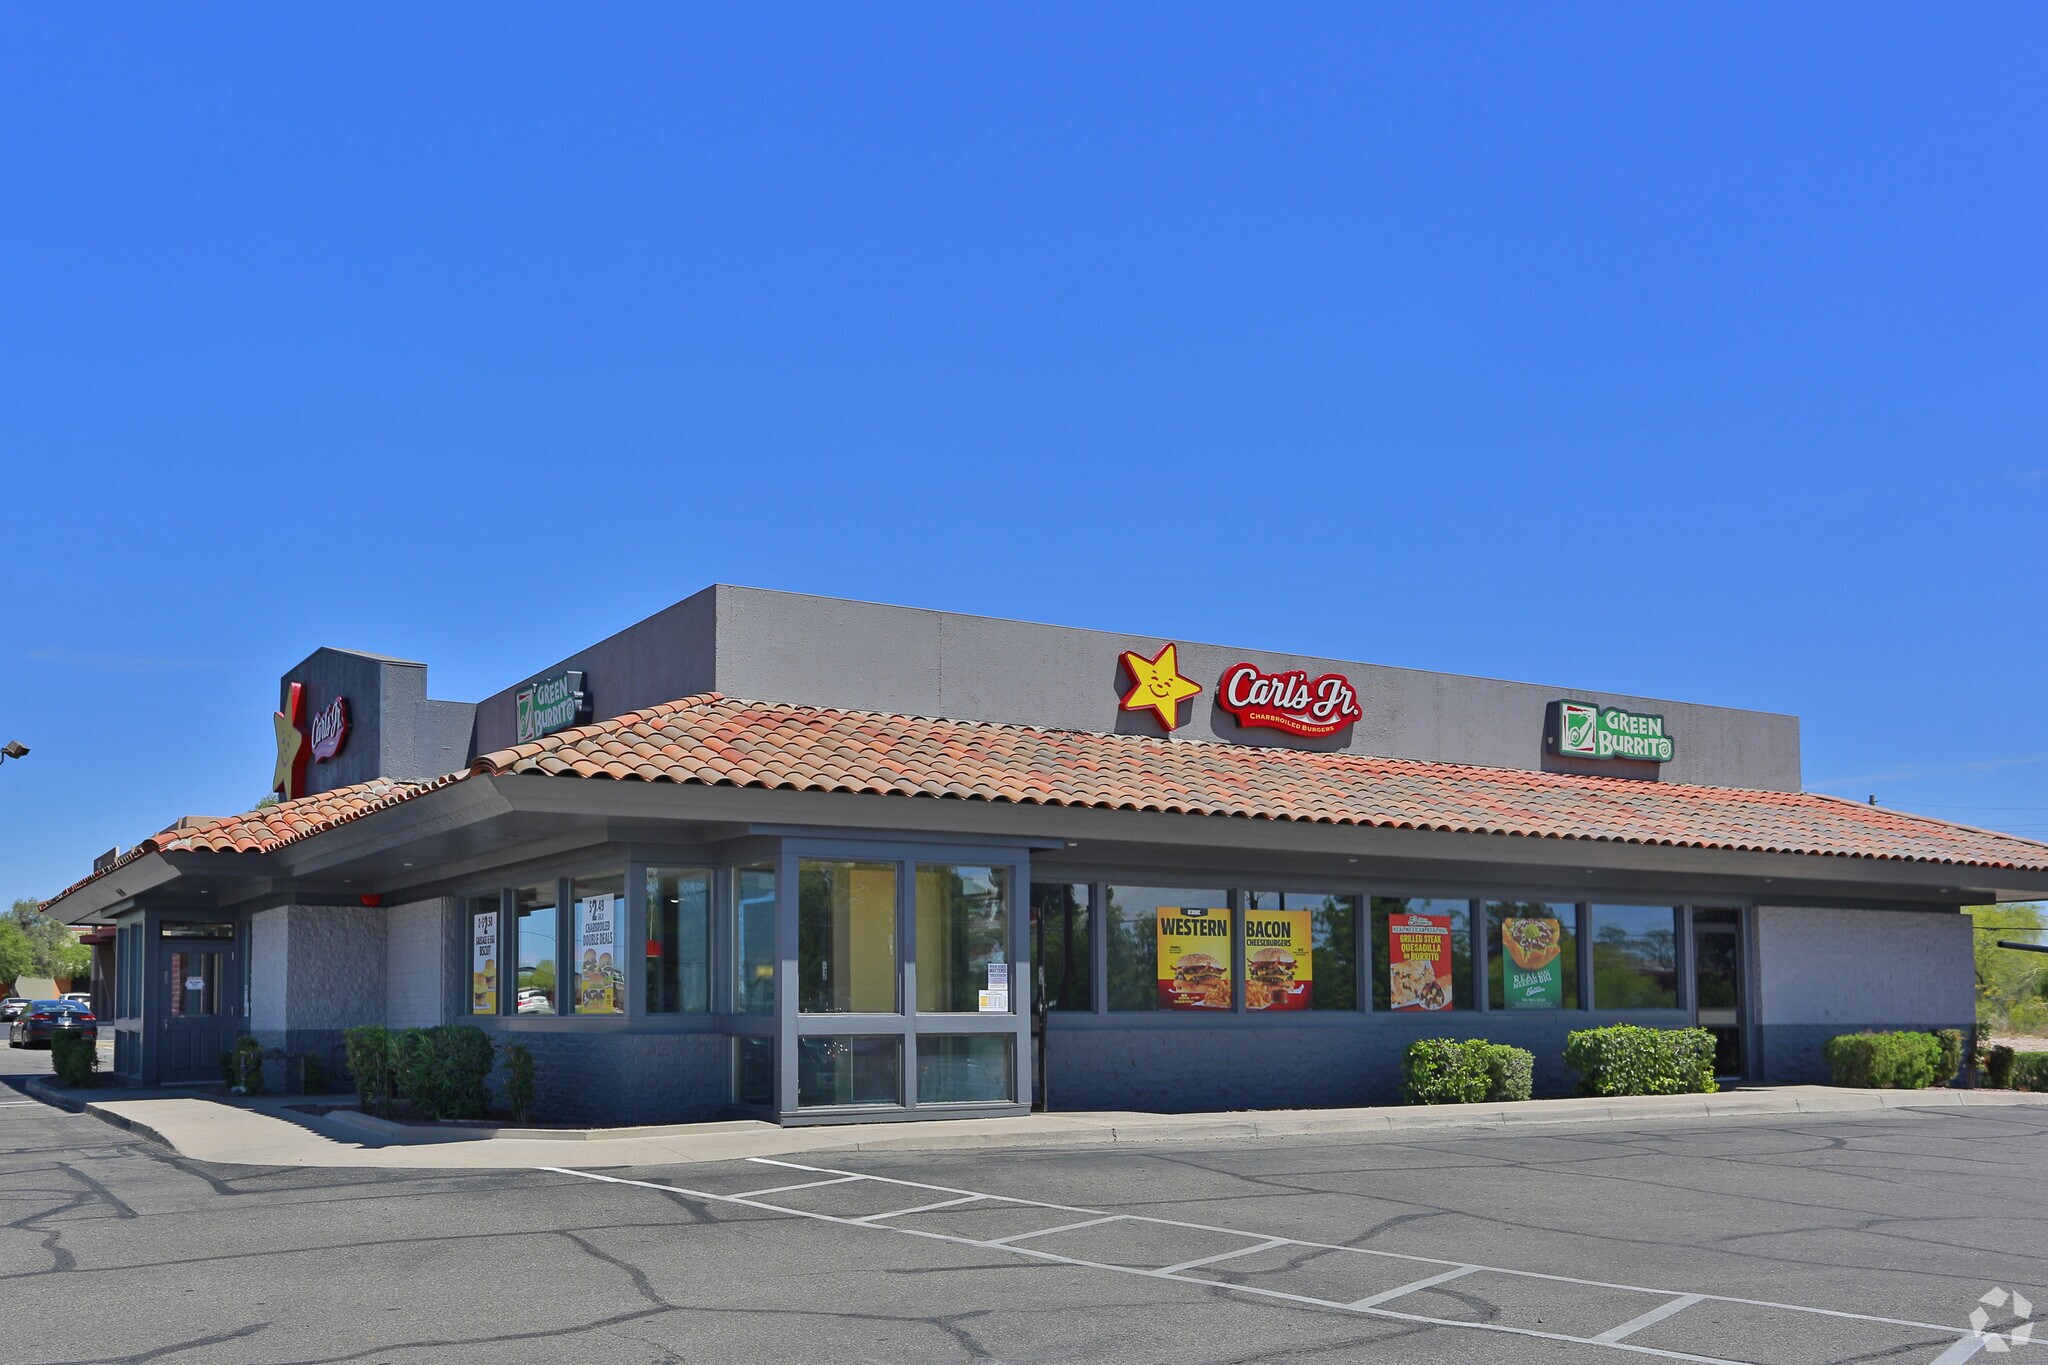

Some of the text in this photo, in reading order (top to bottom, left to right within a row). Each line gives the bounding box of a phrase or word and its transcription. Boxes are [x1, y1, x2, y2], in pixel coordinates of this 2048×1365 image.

[537, 676, 568, 706] GREEN
[1228, 668, 1359, 717] Carl's Jr.
[534, 697, 575, 737] BURRITO
[1249, 712, 1335, 733] CHARBROILED BURGERS
[1605, 711, 1662, 736] GREEN
[312, 716, 332, 749] Carl's
[1598, 730, 1672, 758] BURRITO
[1161, 918, 1228, 937] WESTERN
[1246, 921, 1291, 938] BACON
[583, 932, 613, 946] DOUBLE DEALS
[1246, 939, 1292, 947] CHEESEBURGERS
[1400, 934, 1441, 943] GRILLED STEAK
[1401, 943, 1441, 953] QUESADILLA
[1410, 953, 1440, 961] BURRITO
